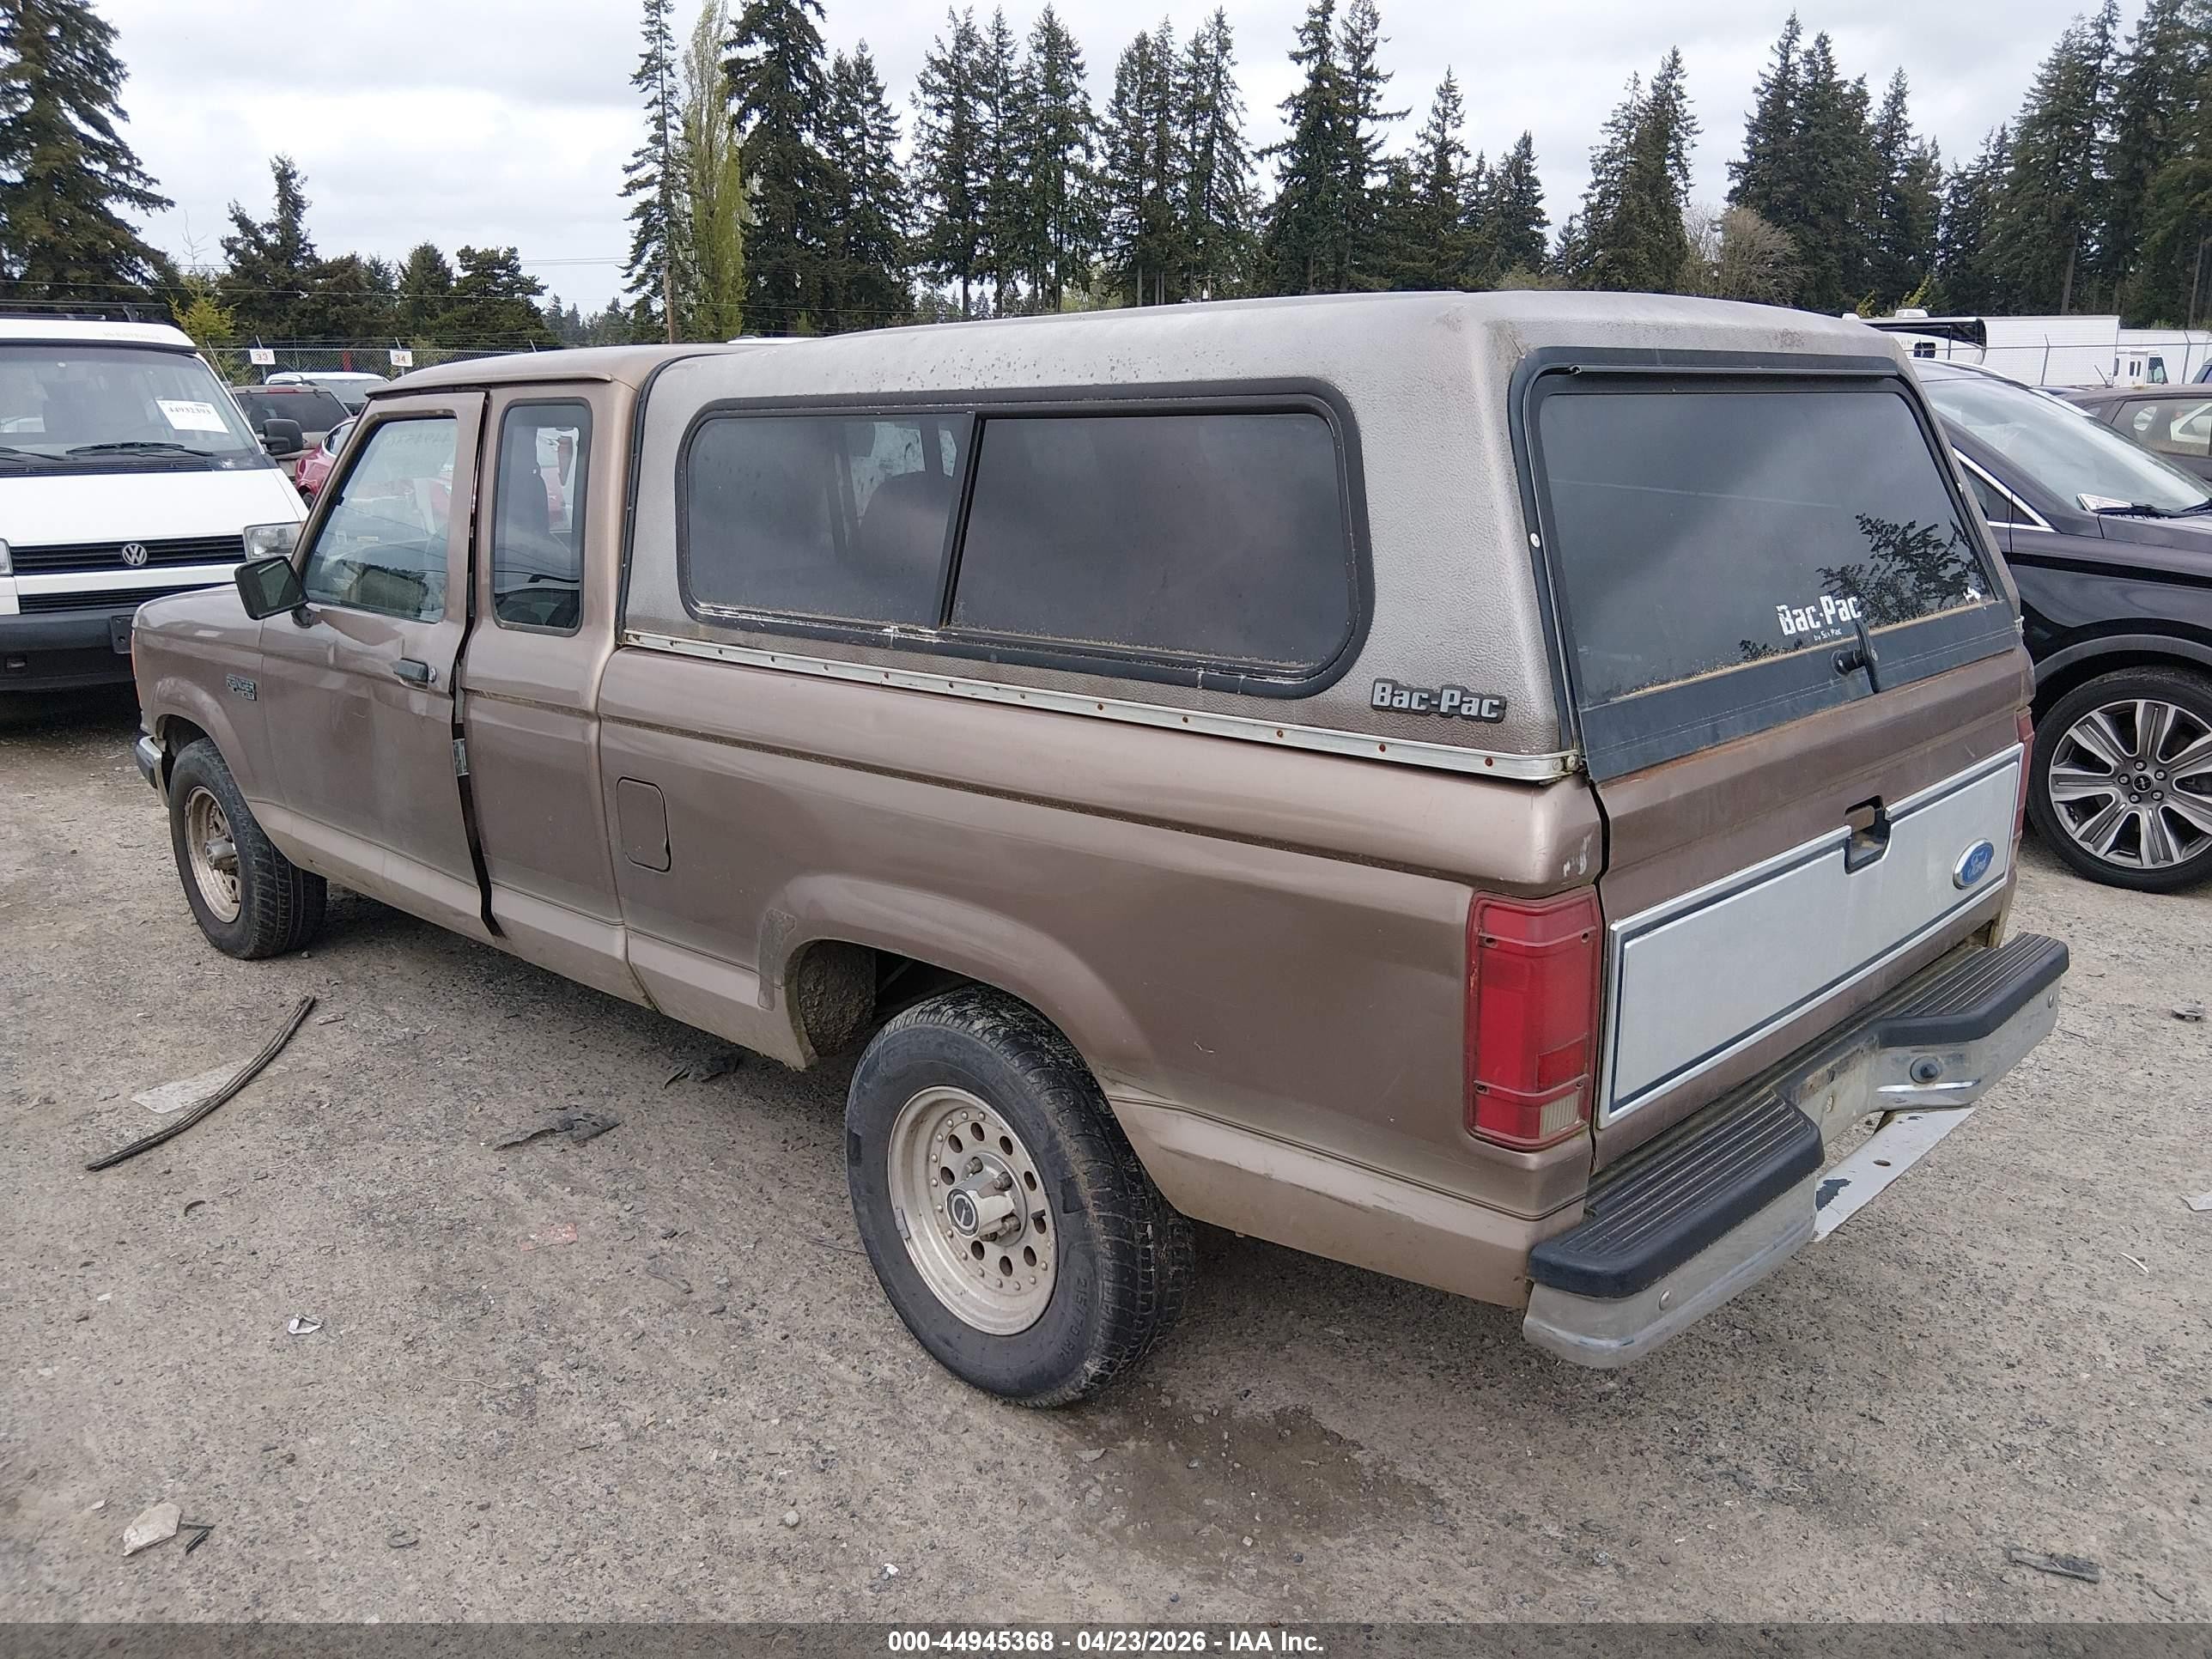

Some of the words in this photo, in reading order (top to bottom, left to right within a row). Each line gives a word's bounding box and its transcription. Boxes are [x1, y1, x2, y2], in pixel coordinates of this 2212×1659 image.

[256, 352, 269, 362] 33
[394, 354, 406, 363] 34
[122, 543, 148, 566] VW
[1372, 682, 1500, 719] Bac-Pac
